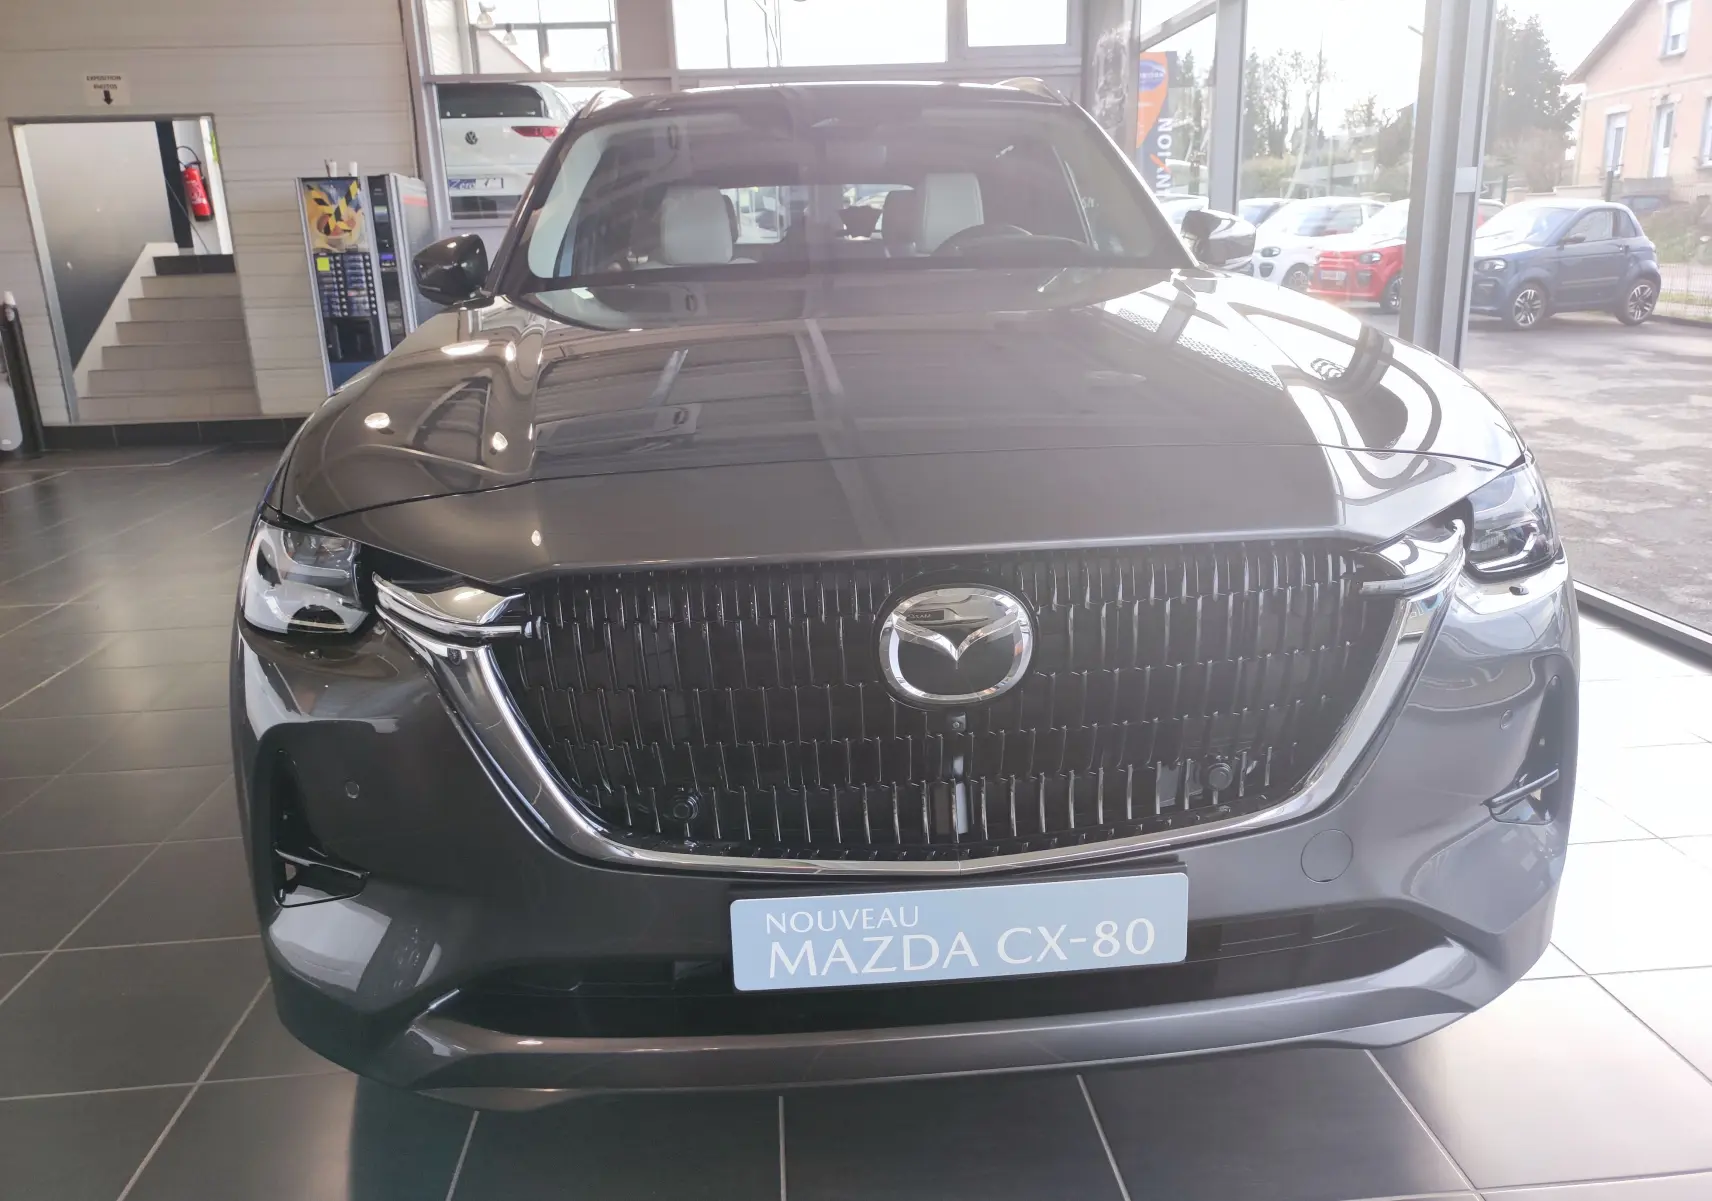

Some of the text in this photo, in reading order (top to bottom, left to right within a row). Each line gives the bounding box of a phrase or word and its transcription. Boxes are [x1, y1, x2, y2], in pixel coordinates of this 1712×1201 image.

[766, 905, 919, 935] NOUVEAU
[769, 917, 1156, 979] MAZDA CX-80
